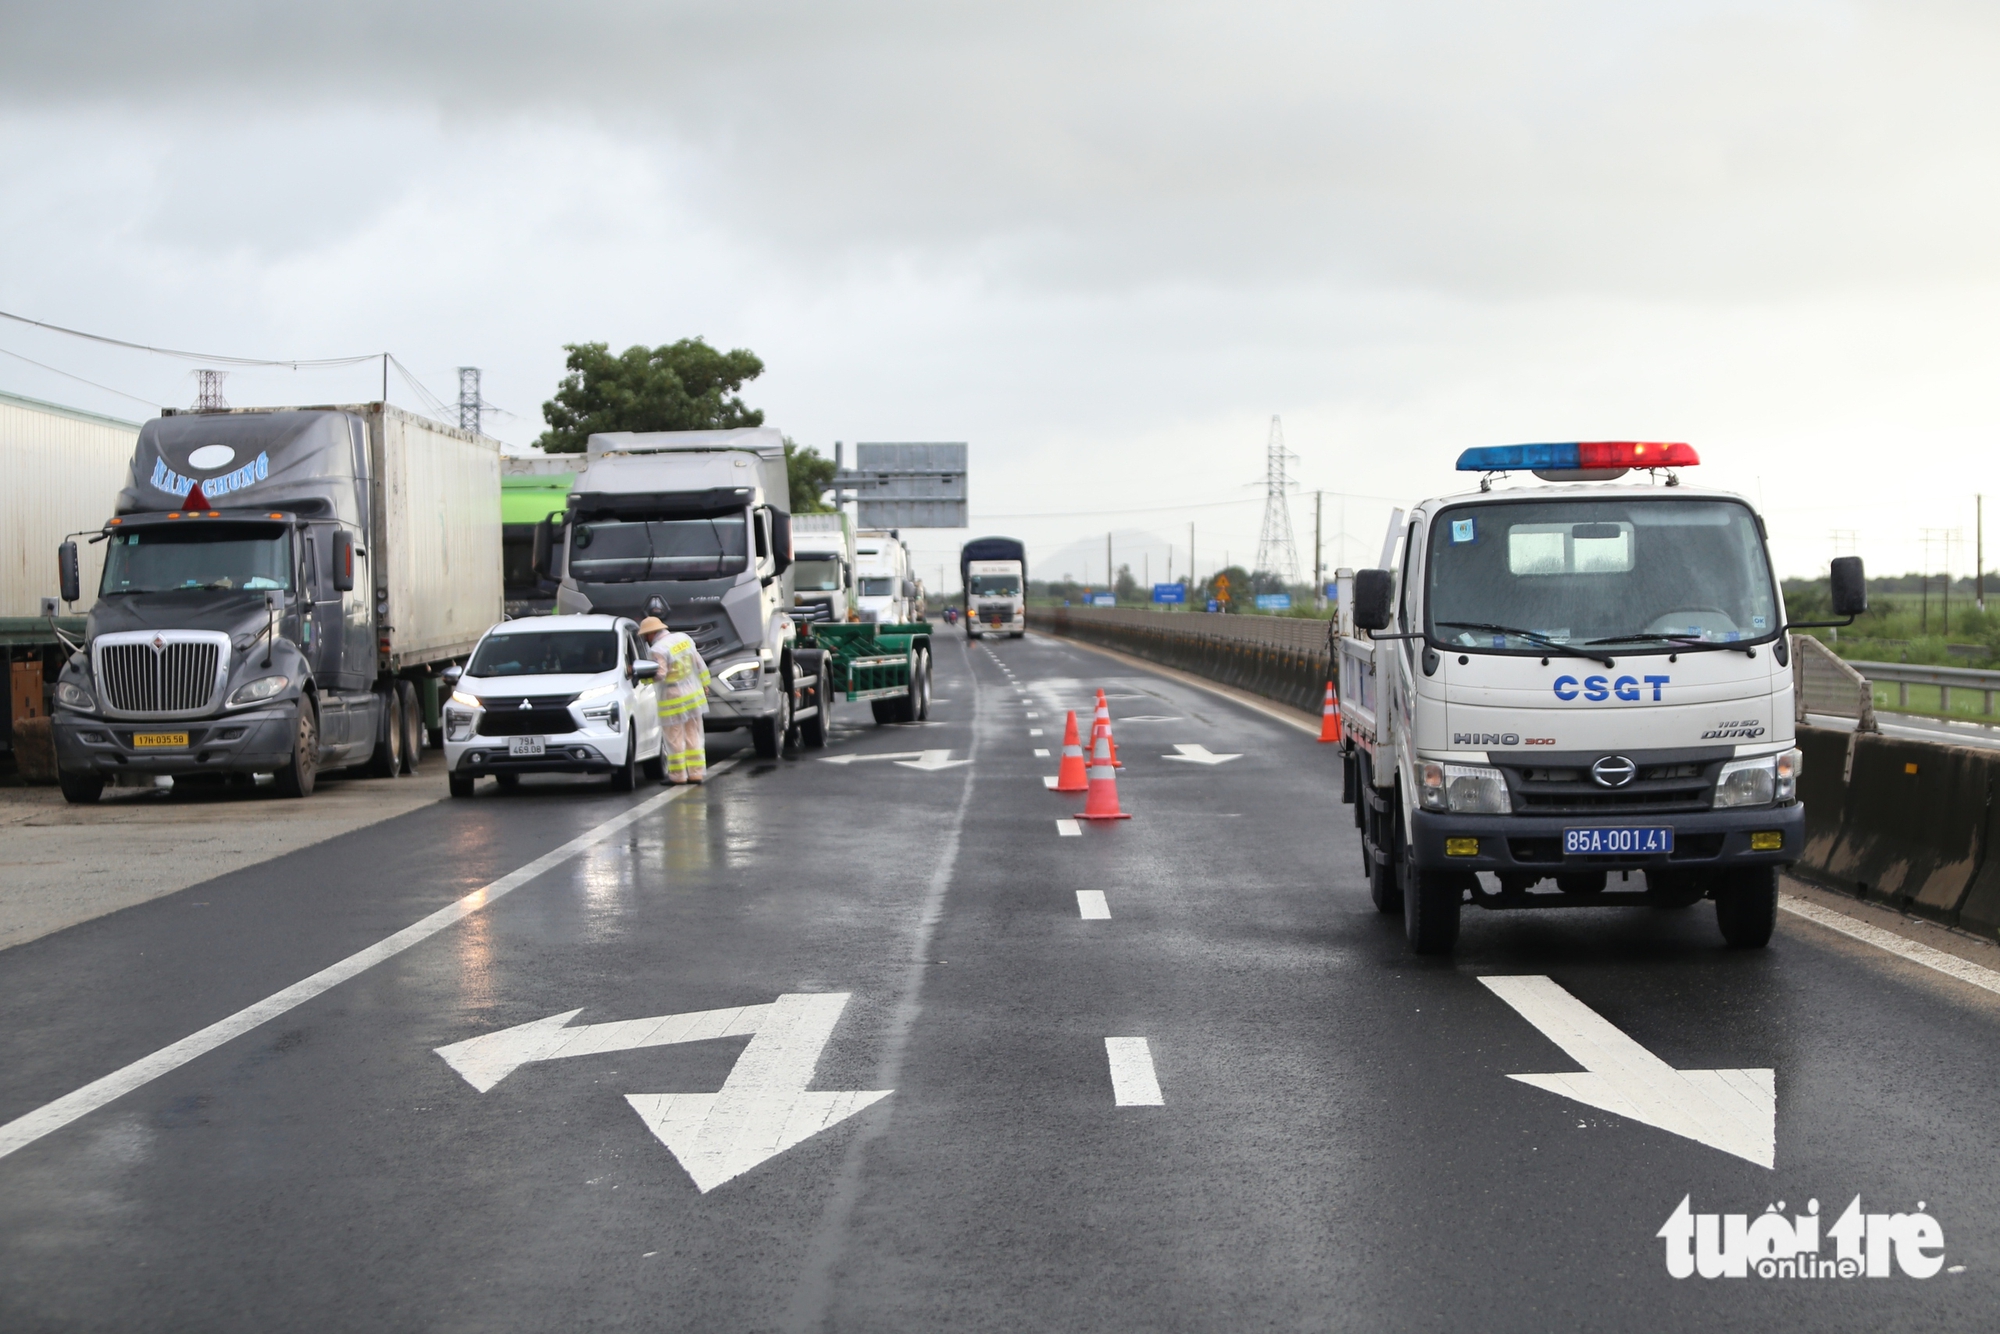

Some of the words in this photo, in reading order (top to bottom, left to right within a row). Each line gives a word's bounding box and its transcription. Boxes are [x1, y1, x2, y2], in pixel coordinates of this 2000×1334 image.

[150, 455, 197, 497] NAM
[201, 450, 269, 498] CHUNG
[1553, 674, 1670, 701] CSGT
[519, 737, 535, 745] 79A
[1453, 732, 1519, 745] HINO
[1700, 727, 1765, 739] DUTRO
[1567, 830, 1666, 851] 85A-001.41
